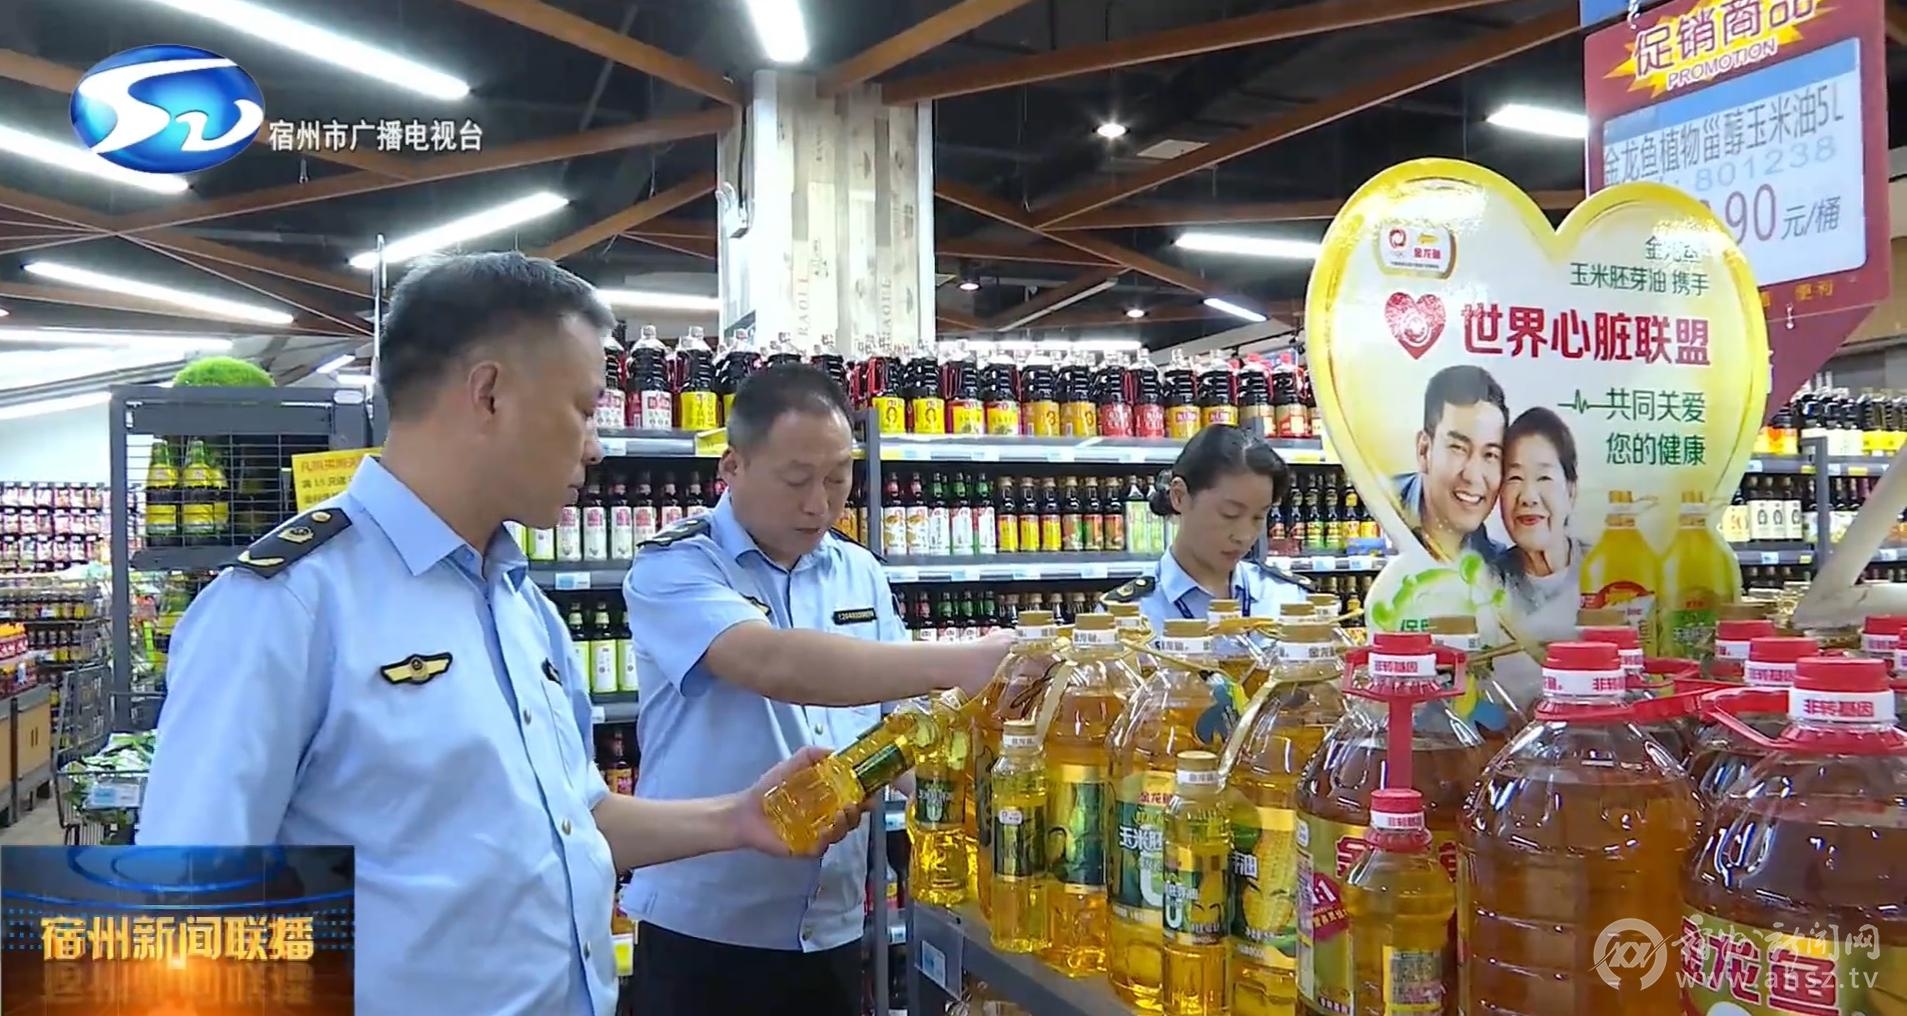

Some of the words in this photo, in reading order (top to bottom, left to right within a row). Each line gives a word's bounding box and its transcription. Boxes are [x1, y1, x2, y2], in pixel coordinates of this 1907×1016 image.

[1635, 0, 1818, 78] 促销商品
[1667, 38, 1778, 90] PROMOTION
[1604, 83, 1845, 187] 金龙鱼植物甾醇玉米油5L
[1782, 195, 1841, 241] 元/桶
[1569, 261, 1667, 294] 玉米胚芽油
[1672, 271, 1710, 297] 携手
[1461, 302, 1712, 367] 世界心脏联盟
[1605, 386, 1707, 423] 共同关爱
[1606, 431, 1706, 467] 您的健康
